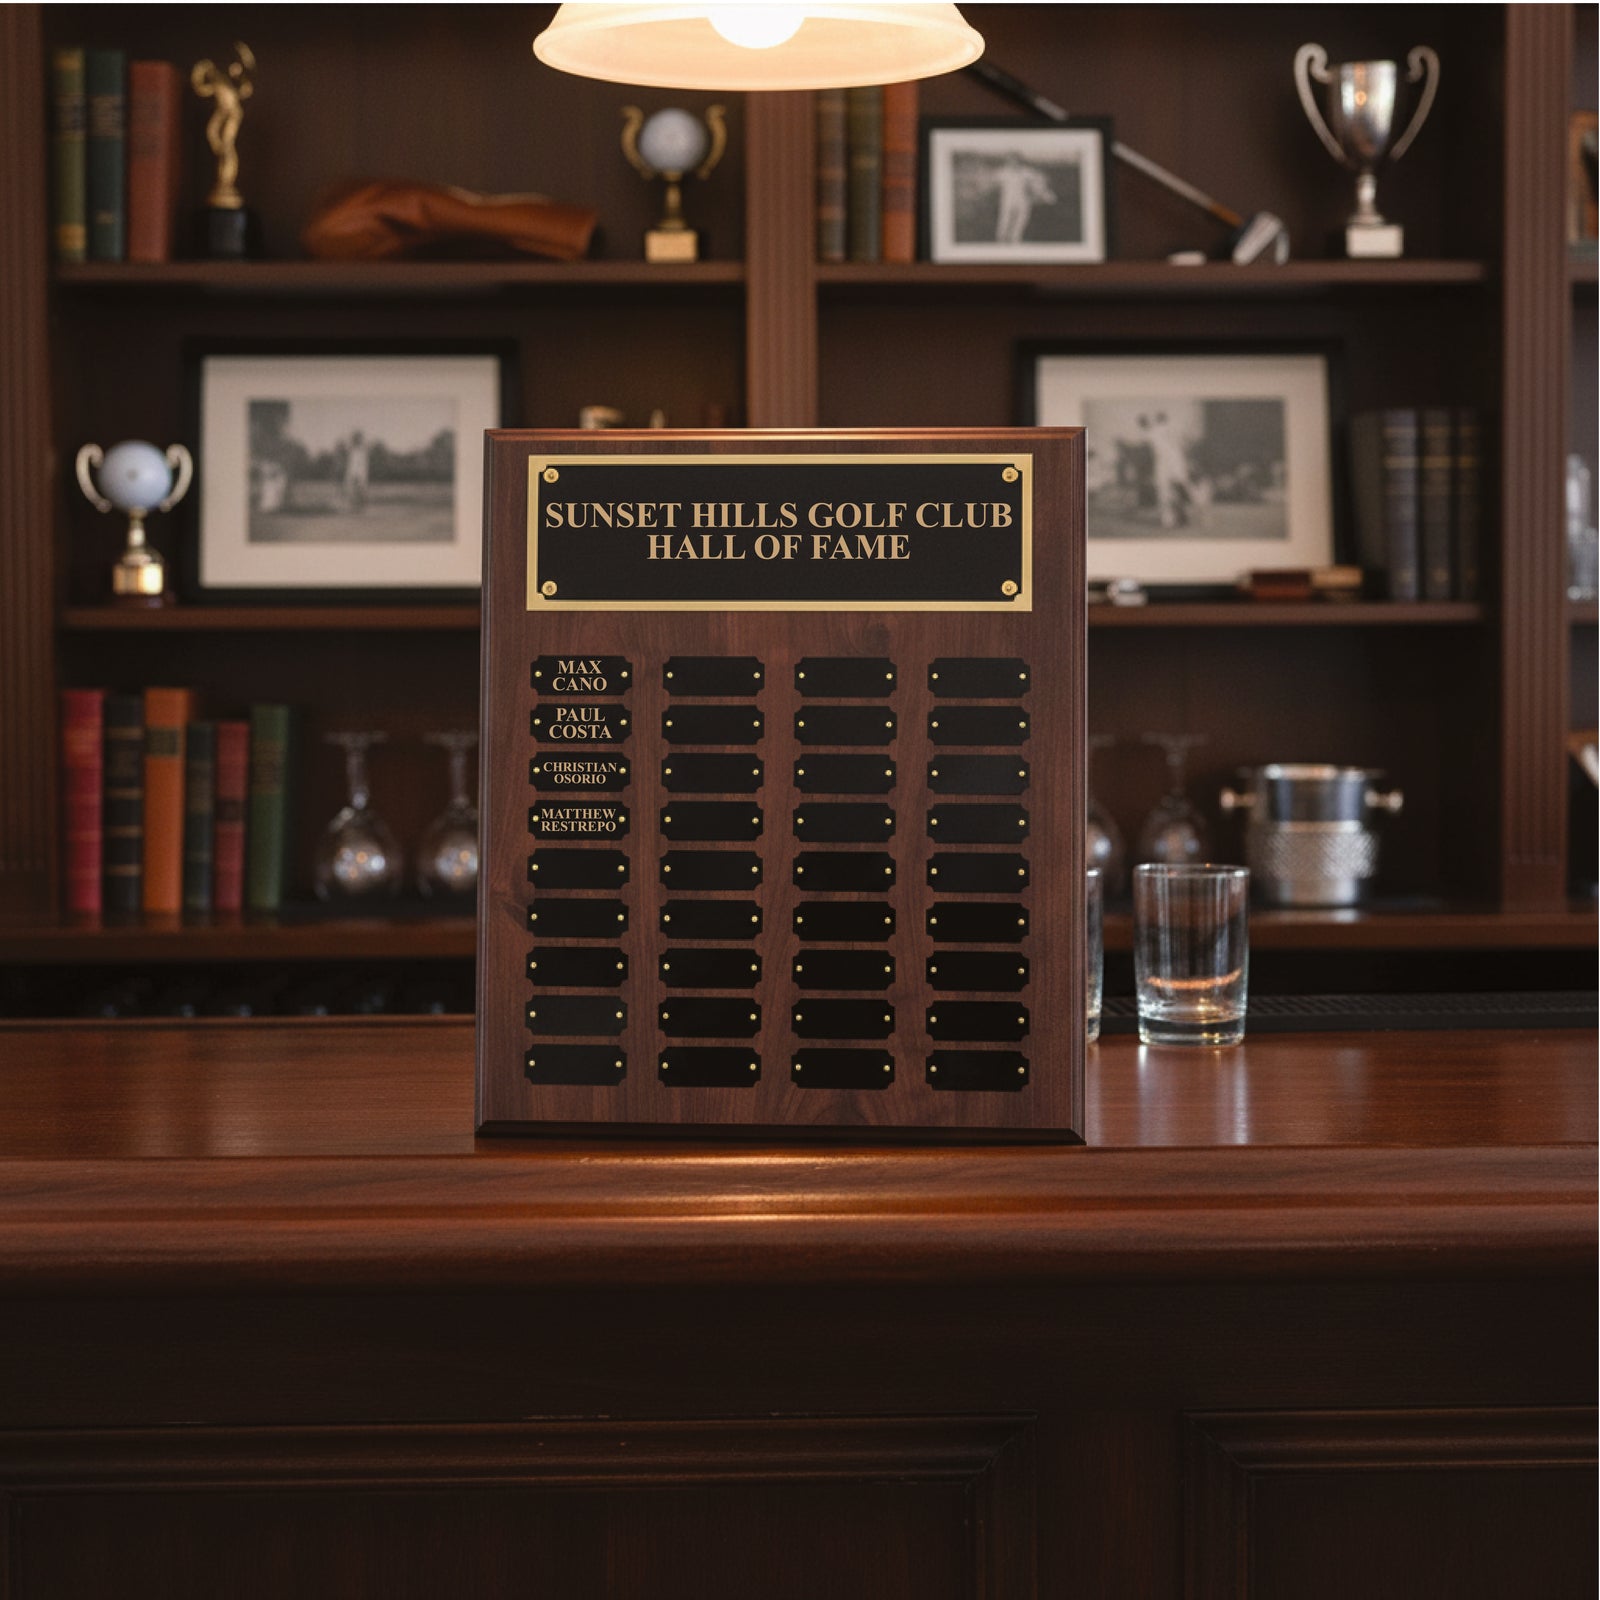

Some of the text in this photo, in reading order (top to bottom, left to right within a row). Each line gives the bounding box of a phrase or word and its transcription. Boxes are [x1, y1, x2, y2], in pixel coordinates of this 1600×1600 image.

[545, 502, 1013, 528] SUNSET HILLS GOLF CLUB
[646, 534, 911, 560] HALL OF FAME
[557, 660, 602, 674] MAX
[552, 677, 608, 691] CANO
[556, 708, 606, 722] PAUL
[548, 724, 613, 739] COSTA
[543, 762, 617, 773] CHRISTIAN
[554, 774, 606, 785] OSORIO
[541, 808, 617, 819] MATTHEW
[541, 821, 617, 832] RESTREPO
